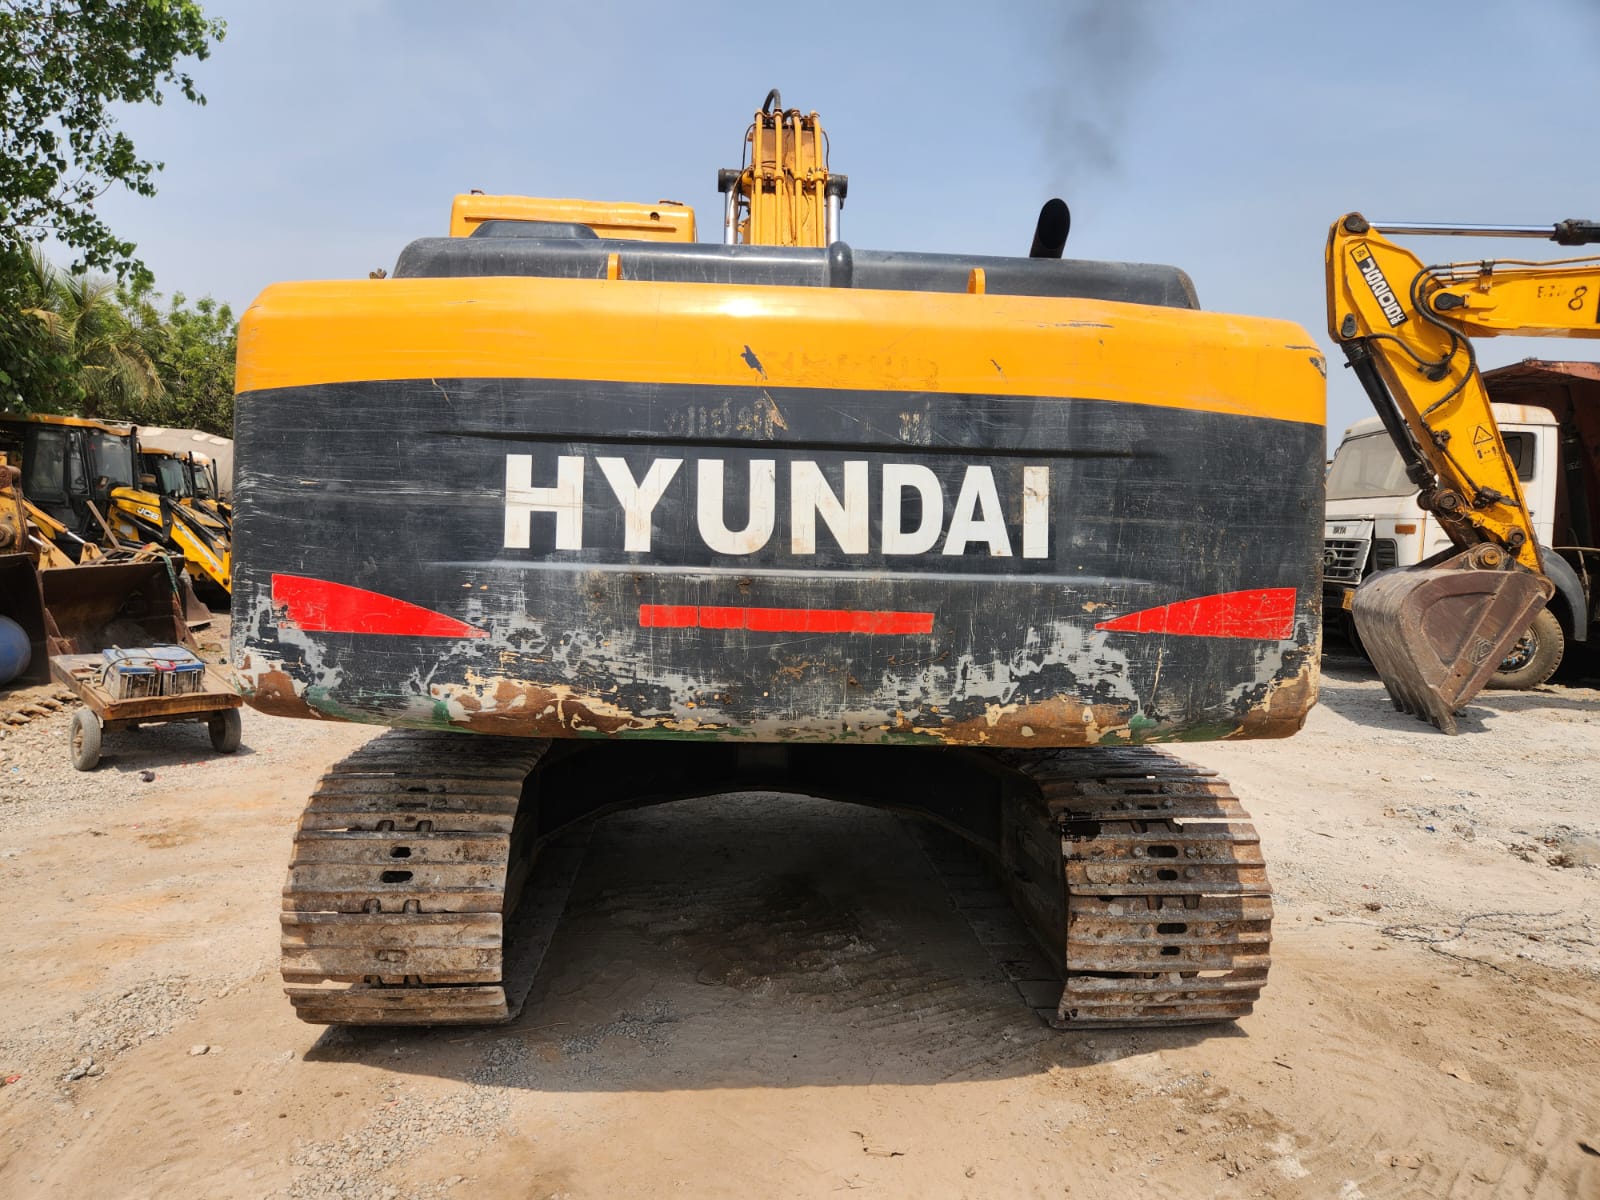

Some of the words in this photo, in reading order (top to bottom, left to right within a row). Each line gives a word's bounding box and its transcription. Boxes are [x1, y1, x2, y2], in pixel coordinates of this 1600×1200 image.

[1568, 285, 1588, 311] 8
[136, 506, 160, 520] JCB
[504, 454, 1050, 558] HYUNDAI
